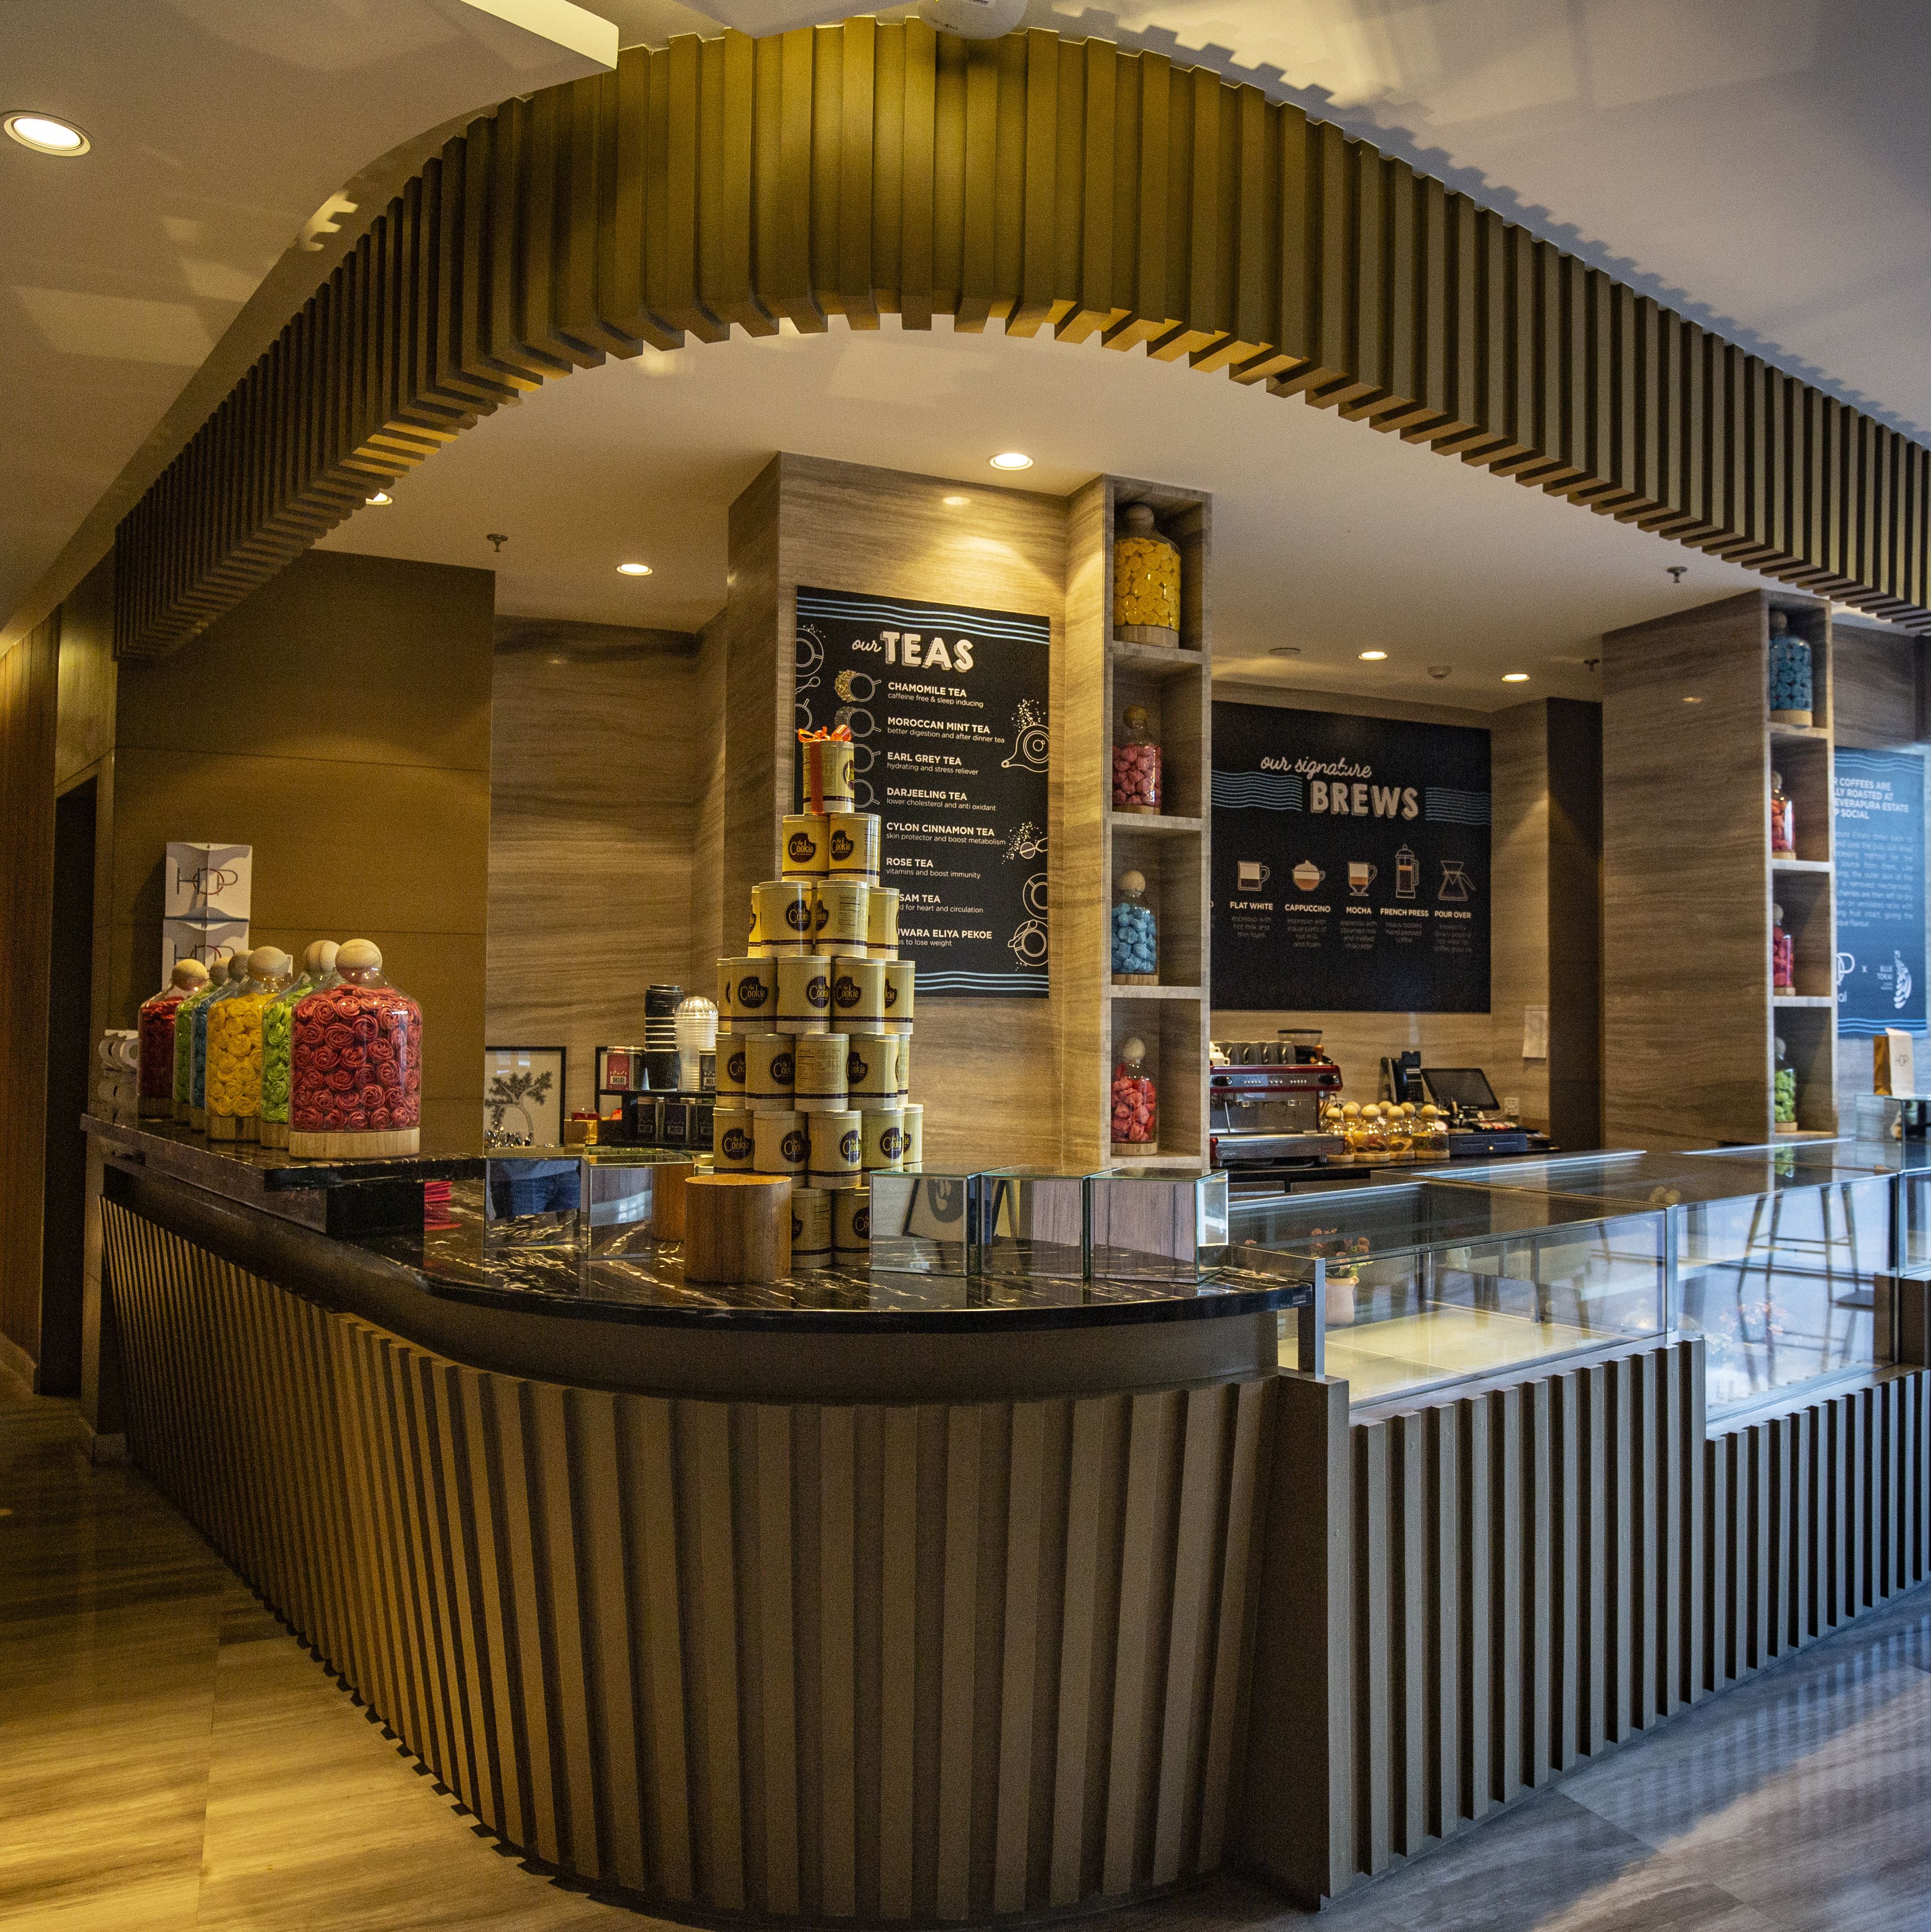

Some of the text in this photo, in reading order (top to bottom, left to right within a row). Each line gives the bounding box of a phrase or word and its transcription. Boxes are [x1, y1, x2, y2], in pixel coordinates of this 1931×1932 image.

[929, 17, 958, 31] aruba
[852, 631, 974, 673] our TEAS
[887, 681, 967, 698] CHAMOMILE TEA
[887, 692, 914, 701] caffeine
[915, 694, 929, 702] free
[937, 697, 955, 705] sleep
[955, 699, 984, 708] inducing
[887, 716, 991, 734] MOROCCAN MINT TEA
[909, 729, 940, 738] digestion
[887, 751, 962, 766] EARL GREY TEA
[887, 762, 919, 772] hydrating
[1260, 756, 1372, 779] our signature
[1839, 777, 1874, 789] COFFEES
[1875, 781, 1892, 791] ARE
[886, 787, 968, 801] DARJEELING TEA
[1309, 780, 1419, 821] BREWS
[1846, 789, 1883, 800] ROASTED
[1884, 793, 1894, 801] AT
[906, 799, 943, 808] cholesterol
[1835, 798, 1910, 813] EVERAPURA ESTATE
[1841, 809, 1870, 820] SOCIAL
[886, 822, 995, 837] CYLON CINNAMON TEA
[790, 840, 813, 855] Cookie
[831, 838, 851, 853] Cookie
[886, 857, 934, 868] ROSE TEA
[177, 866, 238, 895] HOP
[950, 871, 981, 879] immunity
[899, 893, 941, 903] SAM TEA
[1230, 901, 1274, 911] FLAT WHITE
[1284, 903, 1331, 913] CAPPUCCINO
[1346, 907, 1372, 915] MOCHA
[1380, 908, 1429, 917] FRENCH PRESS
[1434, 910, 1452, 918] POUR
[898, 928, 993, 939] WARA ELIYA PEKOE
[740, 984, 765, 1000] Cookie
[836, 984, 858, 1000] Cookie
[885, 985, 895, 999] kie
[724, 1136, 749, 1152] Cookie
